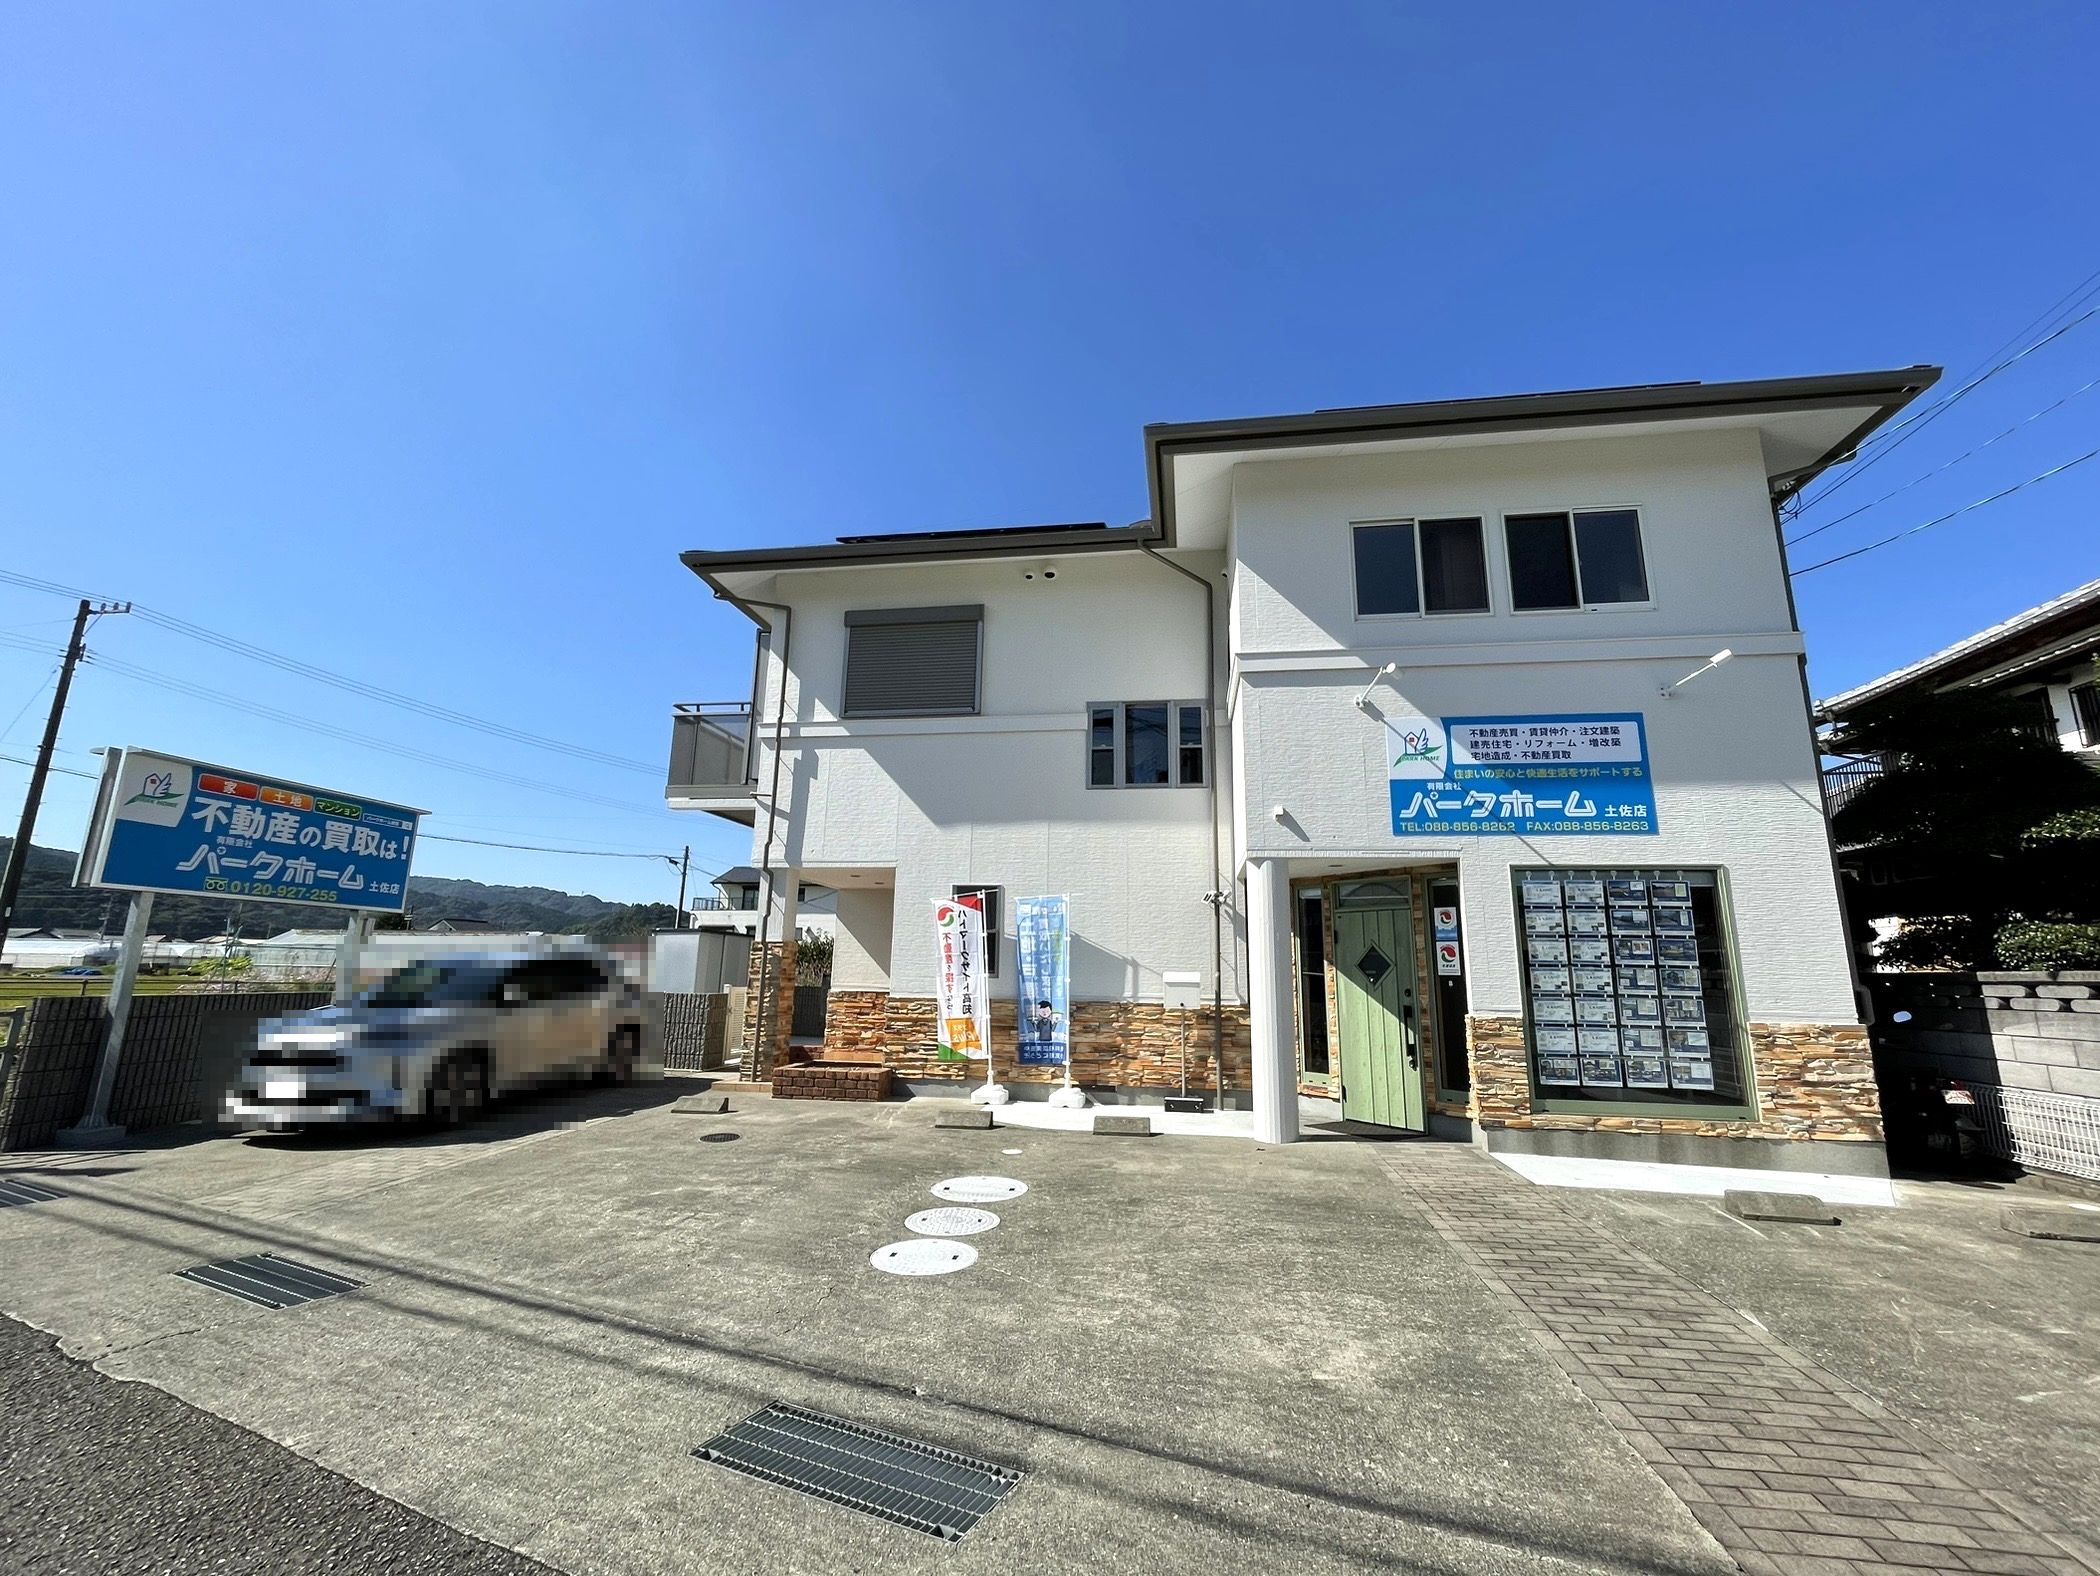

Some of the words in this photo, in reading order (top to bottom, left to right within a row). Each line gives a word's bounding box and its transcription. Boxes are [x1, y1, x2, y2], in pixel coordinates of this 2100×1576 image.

[1469, 726, 1620, 738] 不動産売買・賃貸仲介・注文建築
[1470, 738, 1621, 750] 建売住宅・リフォーム・増改築
[1471, 750, 1572, 761] 宅地造成・不動産買取
[1454, 767, 1642, 779] 住まいの安心と快適生活をサポートする
[223, 781, 236, 794] 家
[1427, 782, 1461, 790] 有限会社
[273, 791, 303, 807] 土地
[1399, 789, 1597, 818] パークホーム
[1604, 804, 1647, 818] 土佐店
[317, 801, 360, 817] マンション
[216, 835, 253, 848] 有限会社
[175, 844, 364, 890] パークホーム
[368, 881, 400, 895] 土佐店
[230, 880, 337, 902] 0120-927-255
